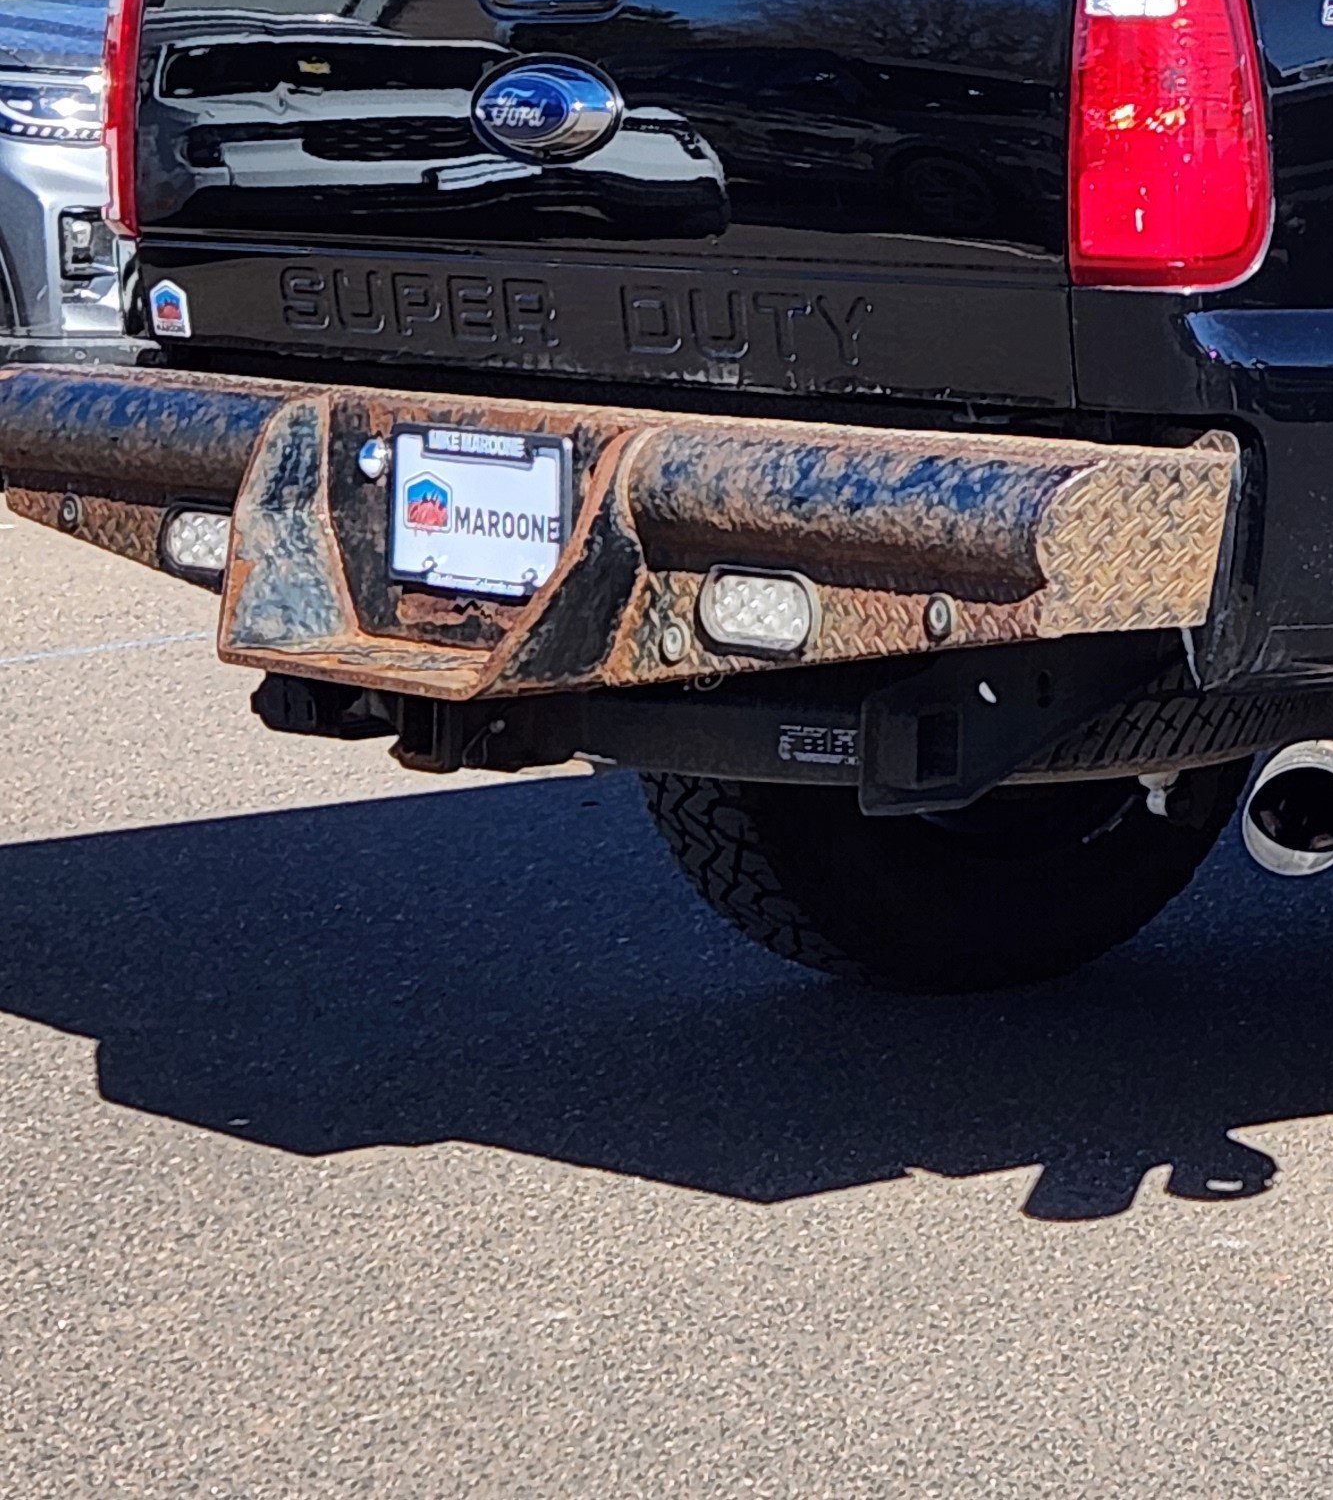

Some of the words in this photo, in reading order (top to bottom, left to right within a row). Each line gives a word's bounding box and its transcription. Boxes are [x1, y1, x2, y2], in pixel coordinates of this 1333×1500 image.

[487, 87, 548, 128] Ford
[279, 265, 561, 348] SUPER
[618, 281, 875, 367] DUTY
[454, 505, 561, 544] MAROONE
